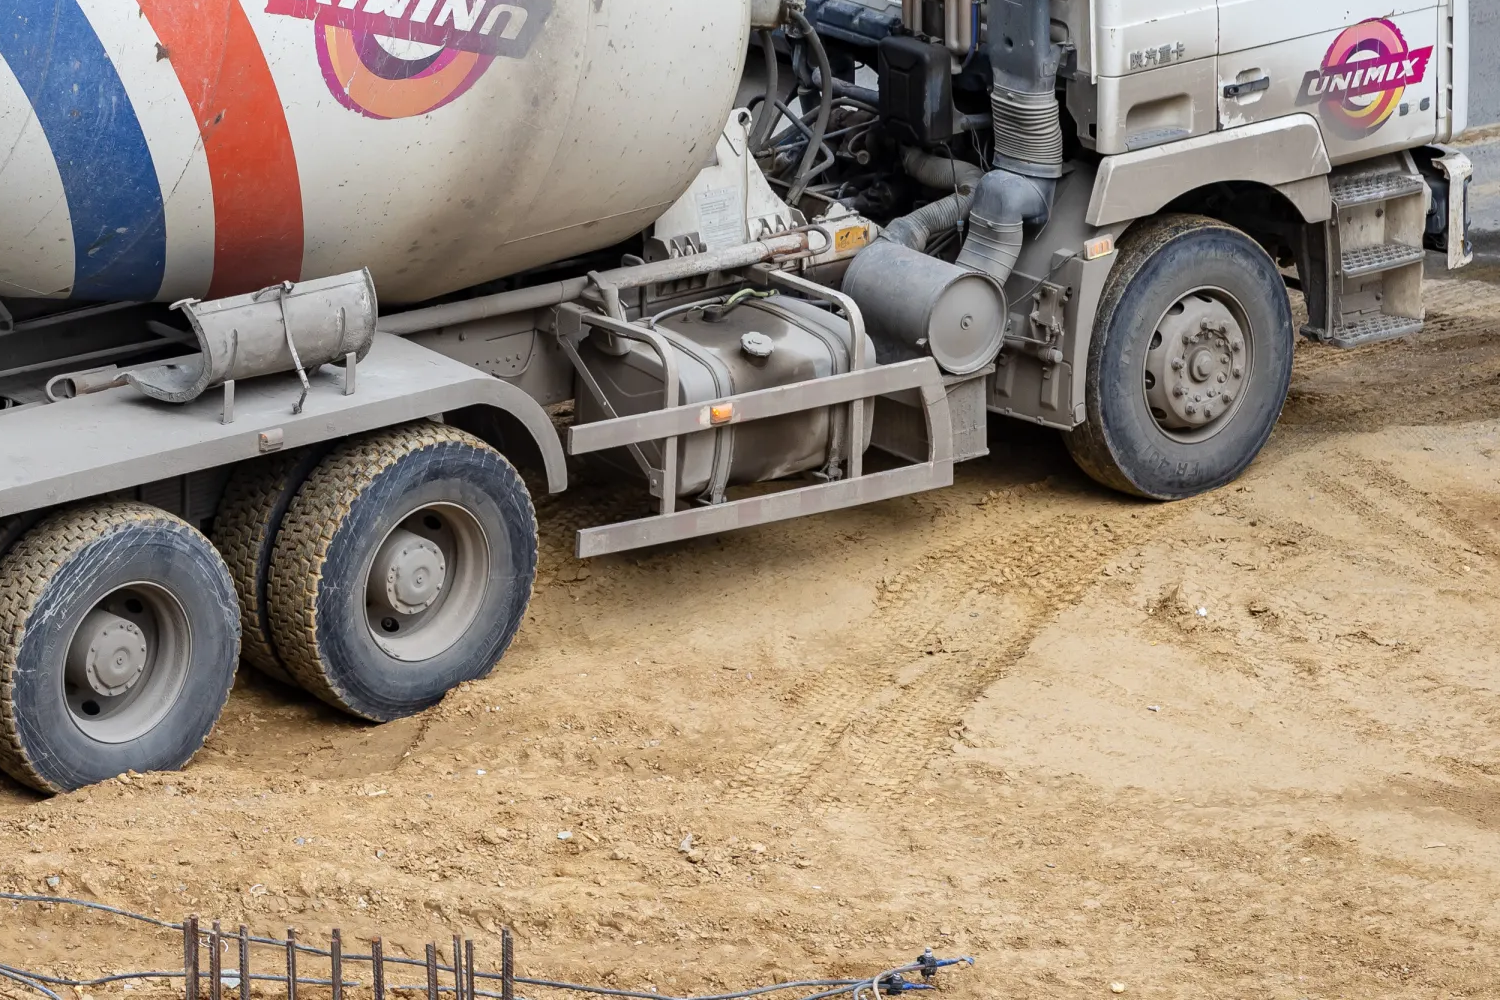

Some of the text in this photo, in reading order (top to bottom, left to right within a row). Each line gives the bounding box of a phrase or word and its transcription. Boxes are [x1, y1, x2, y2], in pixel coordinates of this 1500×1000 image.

[1129, 41, 1185, 70] 陕汽重卡
[1307, 57, 1419, 96] UNIMIX
